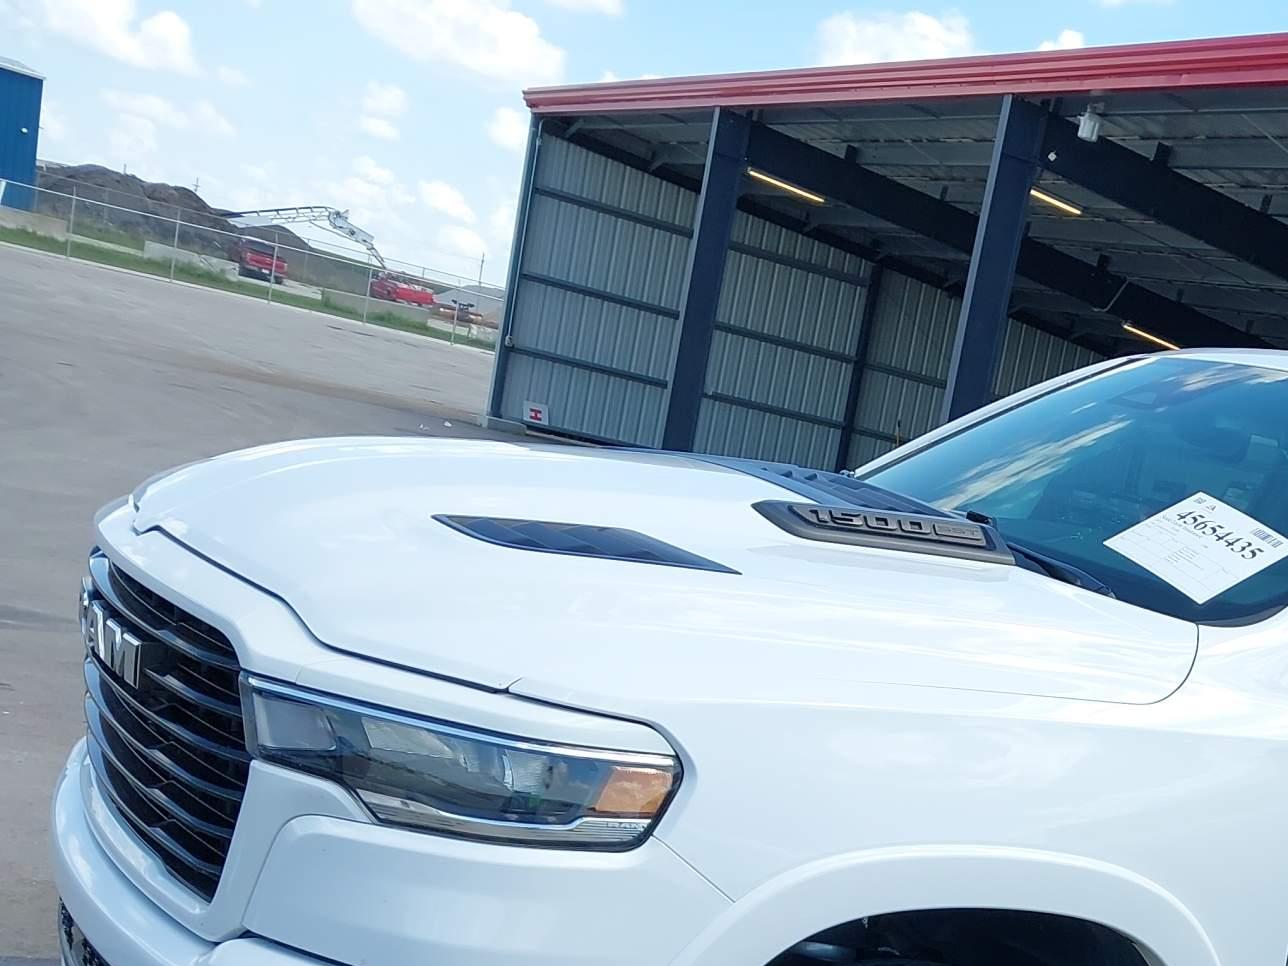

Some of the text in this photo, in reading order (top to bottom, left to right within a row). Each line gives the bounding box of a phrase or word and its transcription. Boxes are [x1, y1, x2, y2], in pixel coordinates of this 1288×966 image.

[811, 508, 932, 535] 1500
[1176, 510, 1265, 560] 45654435
[81, 592, 142, 690] AM
